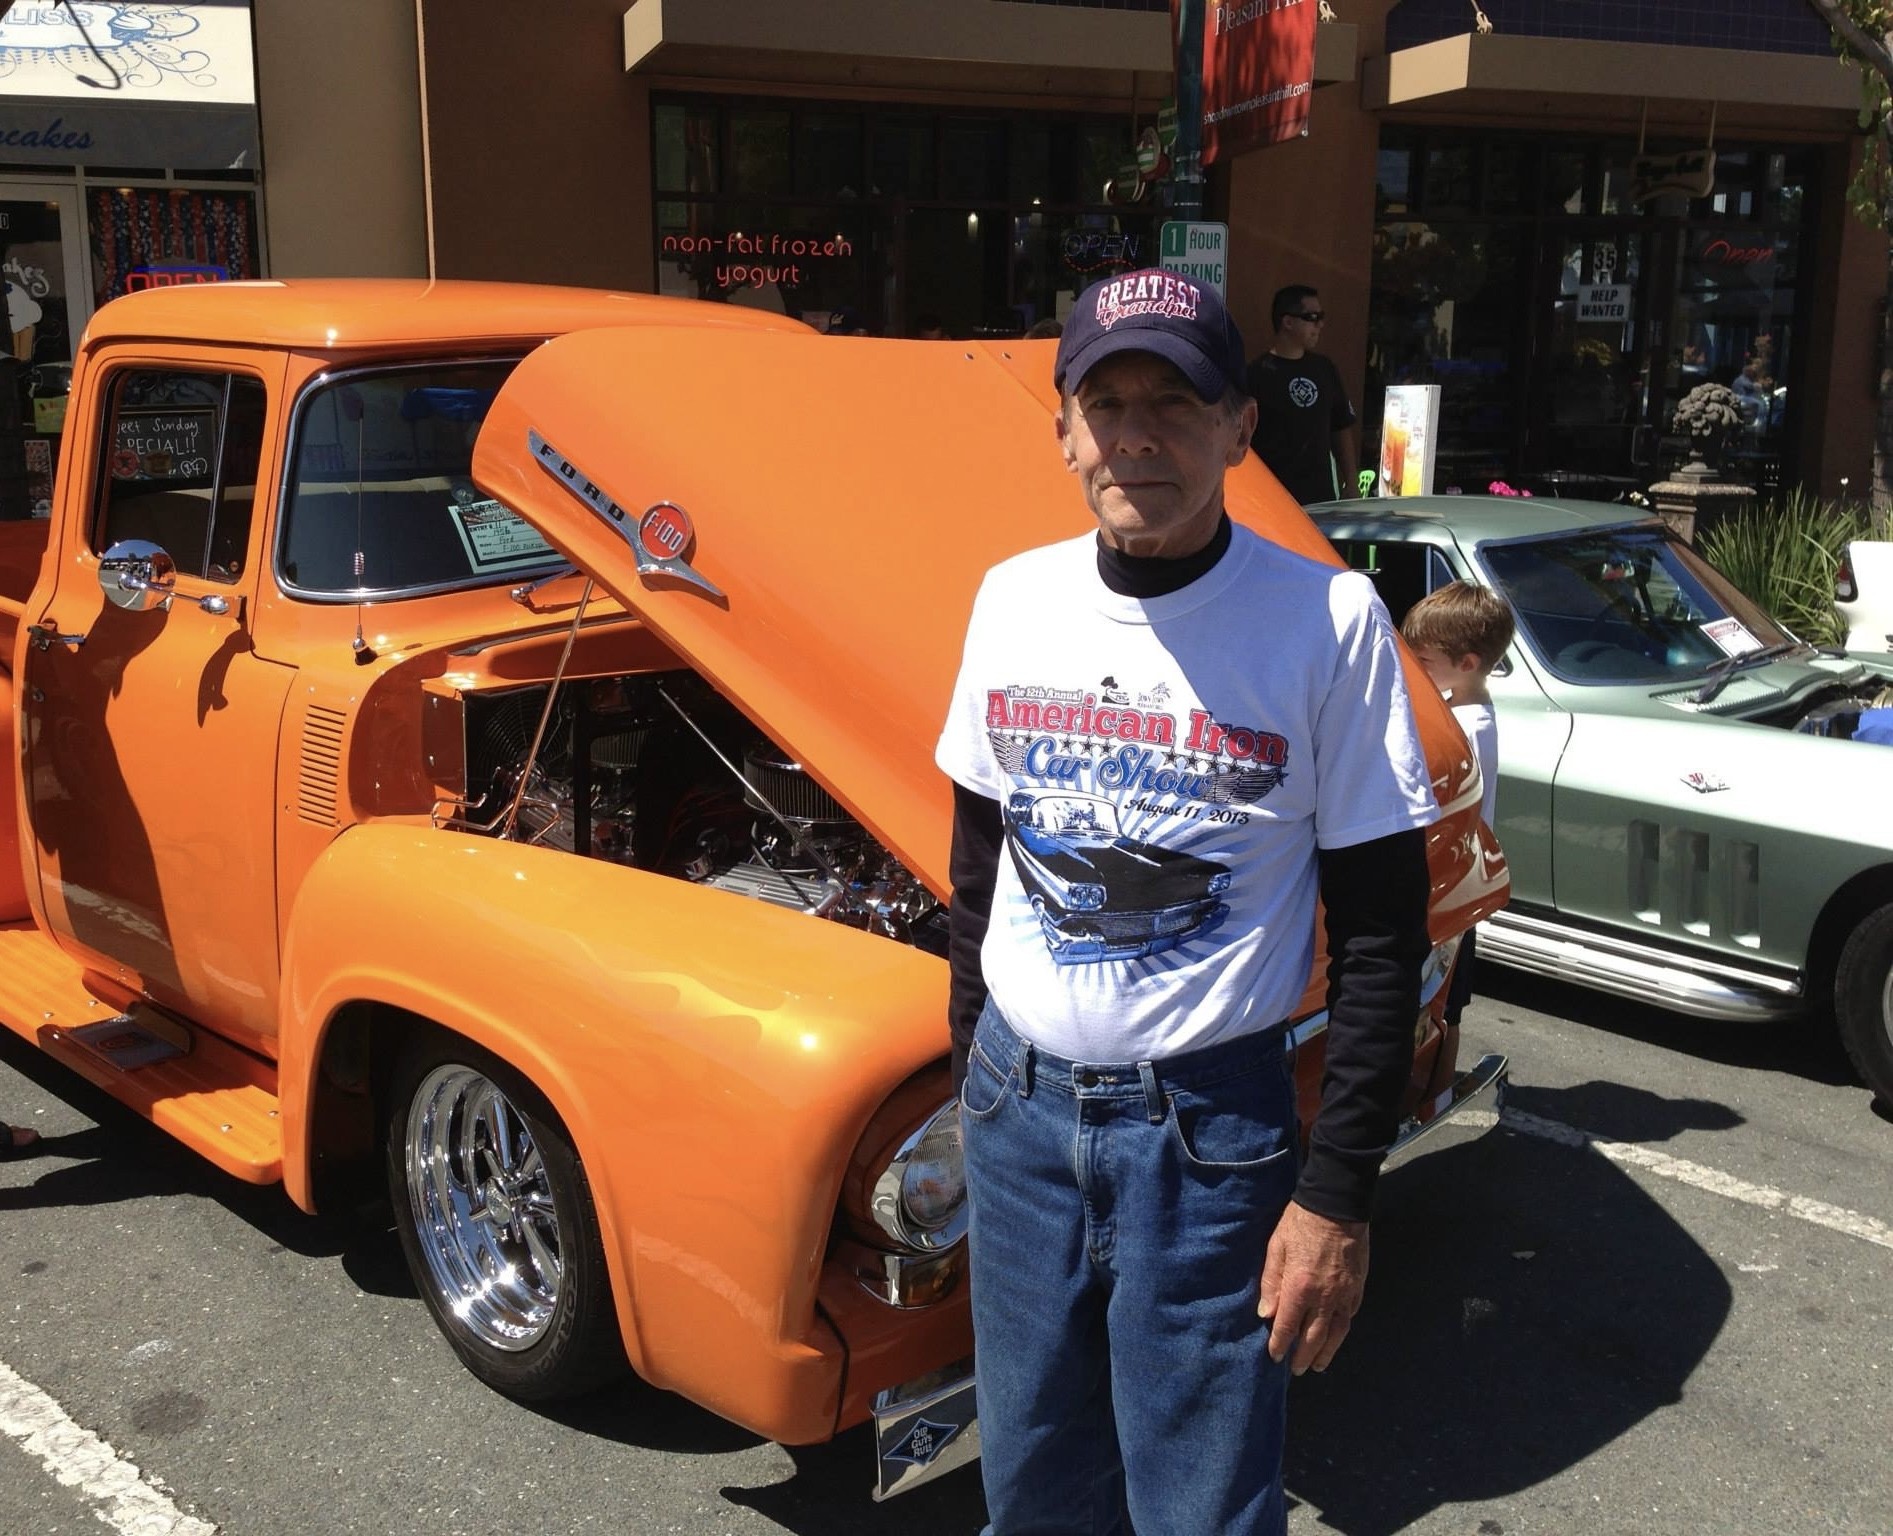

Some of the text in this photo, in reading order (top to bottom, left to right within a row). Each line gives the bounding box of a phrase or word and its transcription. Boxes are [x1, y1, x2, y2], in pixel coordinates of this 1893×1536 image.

[1215, 0, 1270, 36] Pleasant
[0, 117, 92, 149] cakes
[664, 232, 852, 257] non-fat frozen
[1064, 233, 1140, 260] OPEN
[1171, 227, 1222, 252] 1 HOUR
[716, 264, 800, 289] yogurt
[1096, 274, 1201, 319] GREATEST
[1591, 289, 1618, 302] HELP
[1097, 294, 1197, 330] Grandpa
[1581, 304, 1625, 317] WANTED
[152, 417, 199, 438] Sunday
[540, 443, 626, 523] FORD
[1007, 685, 1026, 699] The
[1047, 687, 1083, 703] Annual
[986, 689, 1289, 768] American Iron
[1023, 735, 1211, 799] Car Show
[1124, 797, 1180, 819] August
[1207, 808, 1251, 825] 2013
[911, 1431, 932, 1449] GUYS
[913, 1426, 928, 1439] OLD
[913, 1442, 933, 1458] RULE
